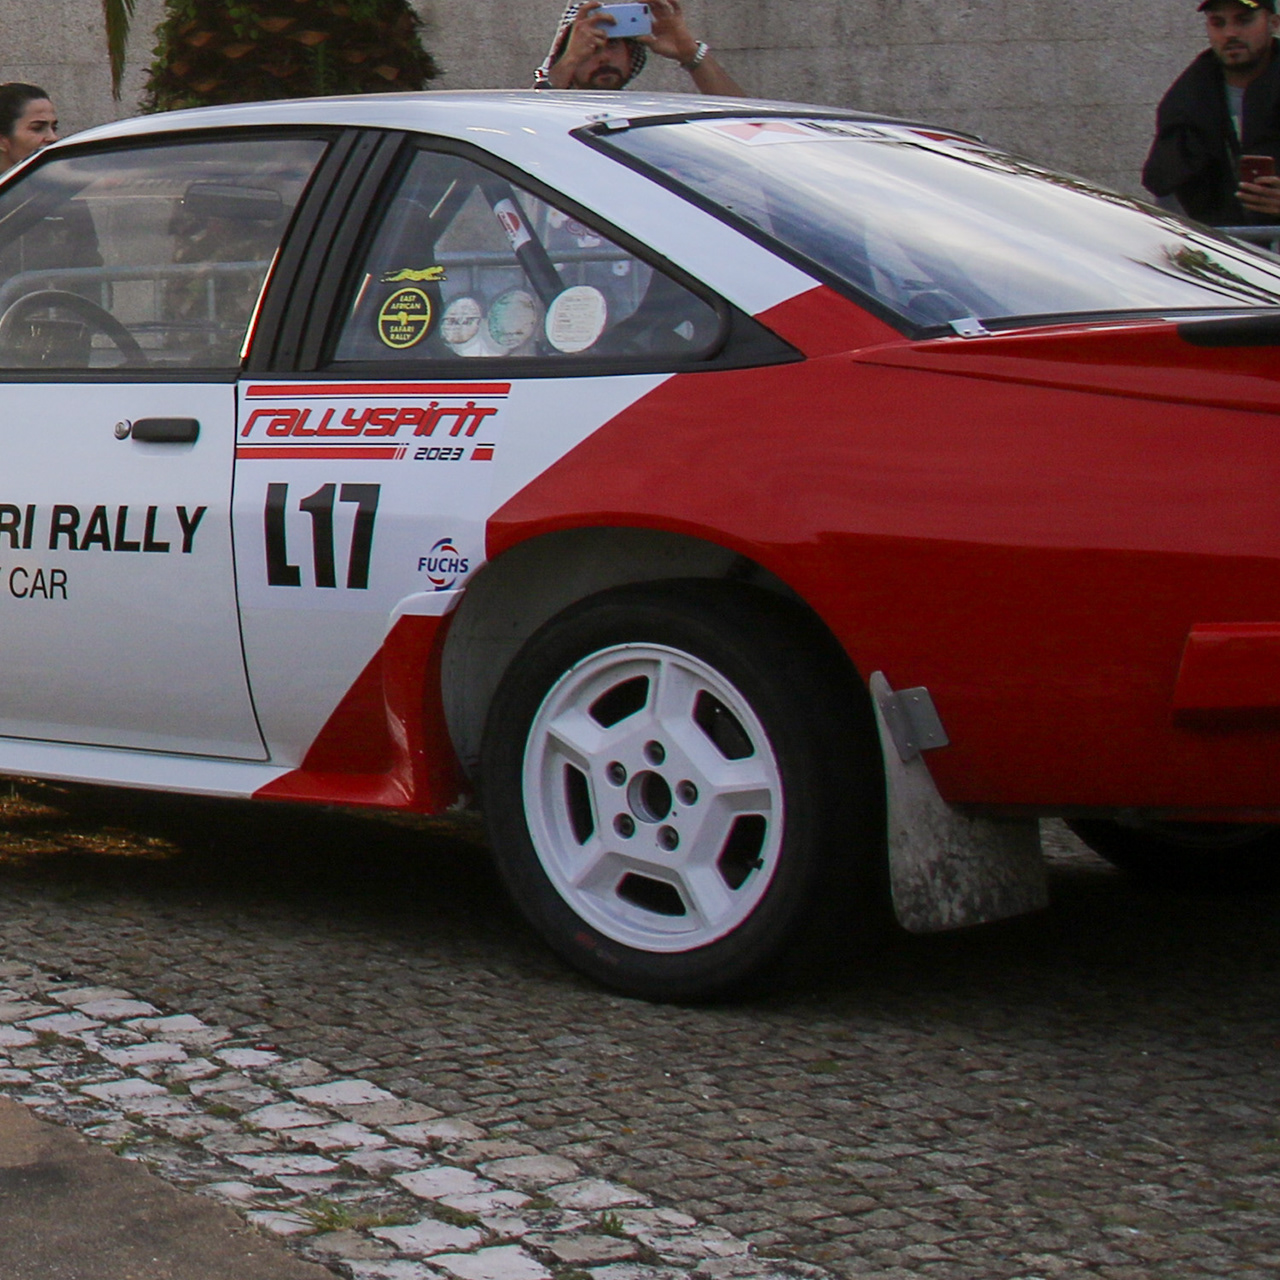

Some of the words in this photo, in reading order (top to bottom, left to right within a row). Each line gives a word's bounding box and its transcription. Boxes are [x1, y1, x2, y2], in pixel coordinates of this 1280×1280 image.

[399, 294, 417, 303] EAST
[390, 302, 421, 310] AFRICAN
[389, 325, 415, 333] SAFARI
[389, 333, 412, 341] RALLY
[413, 447, 465, 461] 2023
[48, 503, 208, 555] RALLY
[264, 482, 382, 590] L17
[417, 556, 469, 574] FUCHS
[8, 566, 69, 600] CAR
